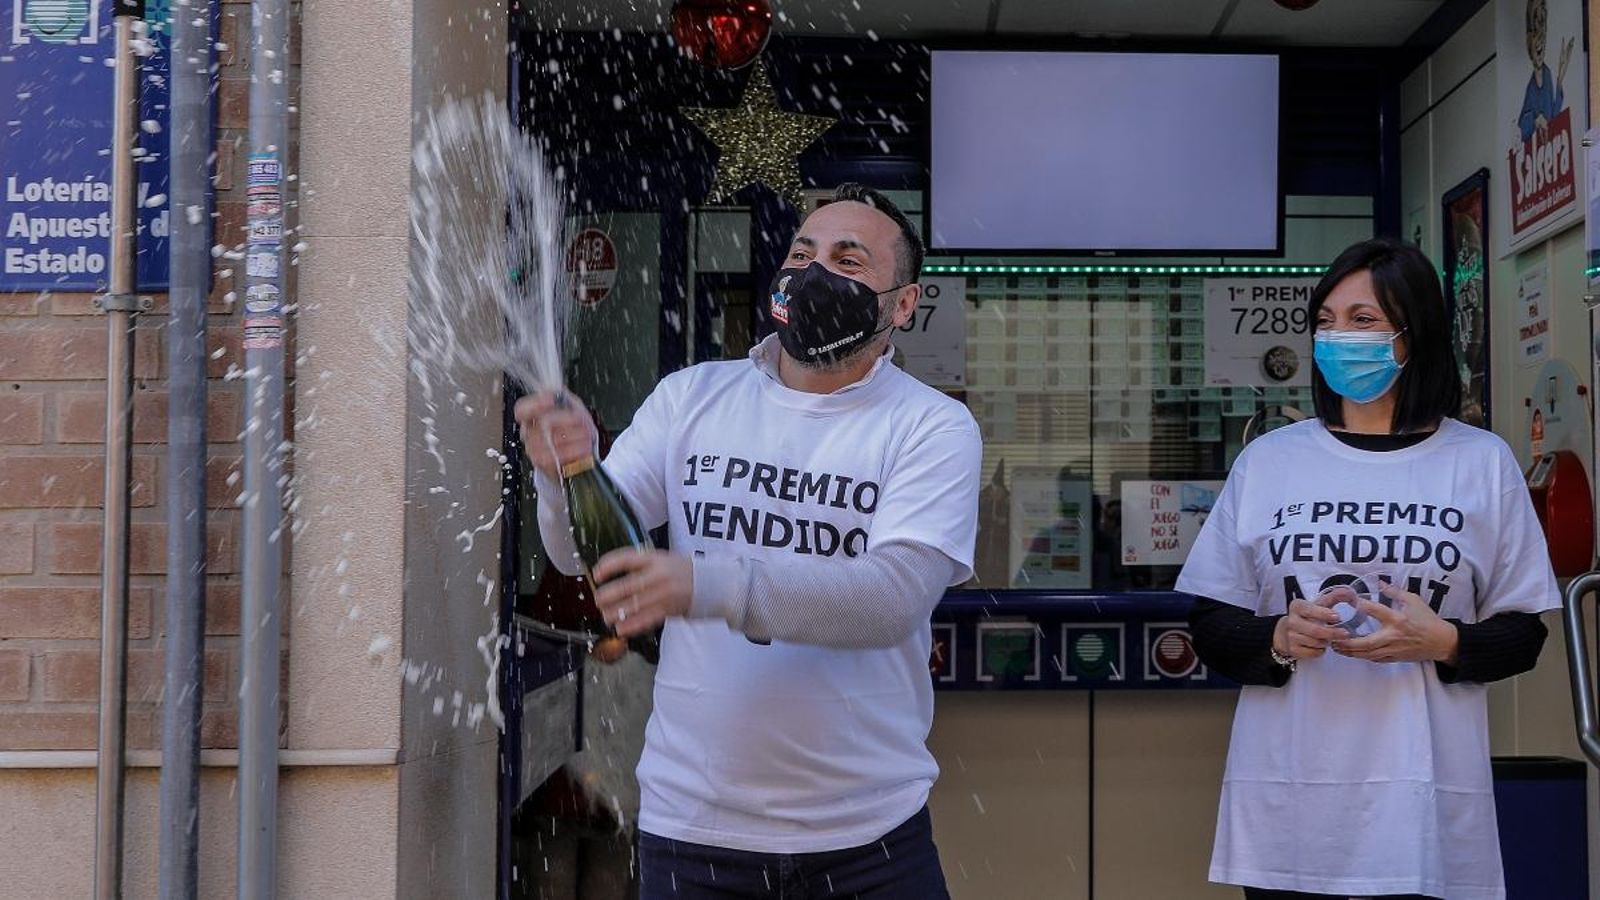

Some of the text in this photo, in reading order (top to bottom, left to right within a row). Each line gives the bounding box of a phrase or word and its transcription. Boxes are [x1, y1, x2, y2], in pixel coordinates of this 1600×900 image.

[1515, 129, 1570, 205] Salsera
[7, 175, 113, 202] Lotería
[5, 246, 105, 274] Estado
[1251, 286, 1315, 301] PREMI
[1230, 307, 1309, 335] 7289
[683, 454, 880, 515] 1er PREMIO
[1151, 484, 1171, 496] CON
[682, 501, 869, 558] VENDIDO
[1270, 501, 1465, 533] 1er PREMIO
[1151, 526, 1166, 537] NO
[1268, 533, 1461, 573] VENDIDO
